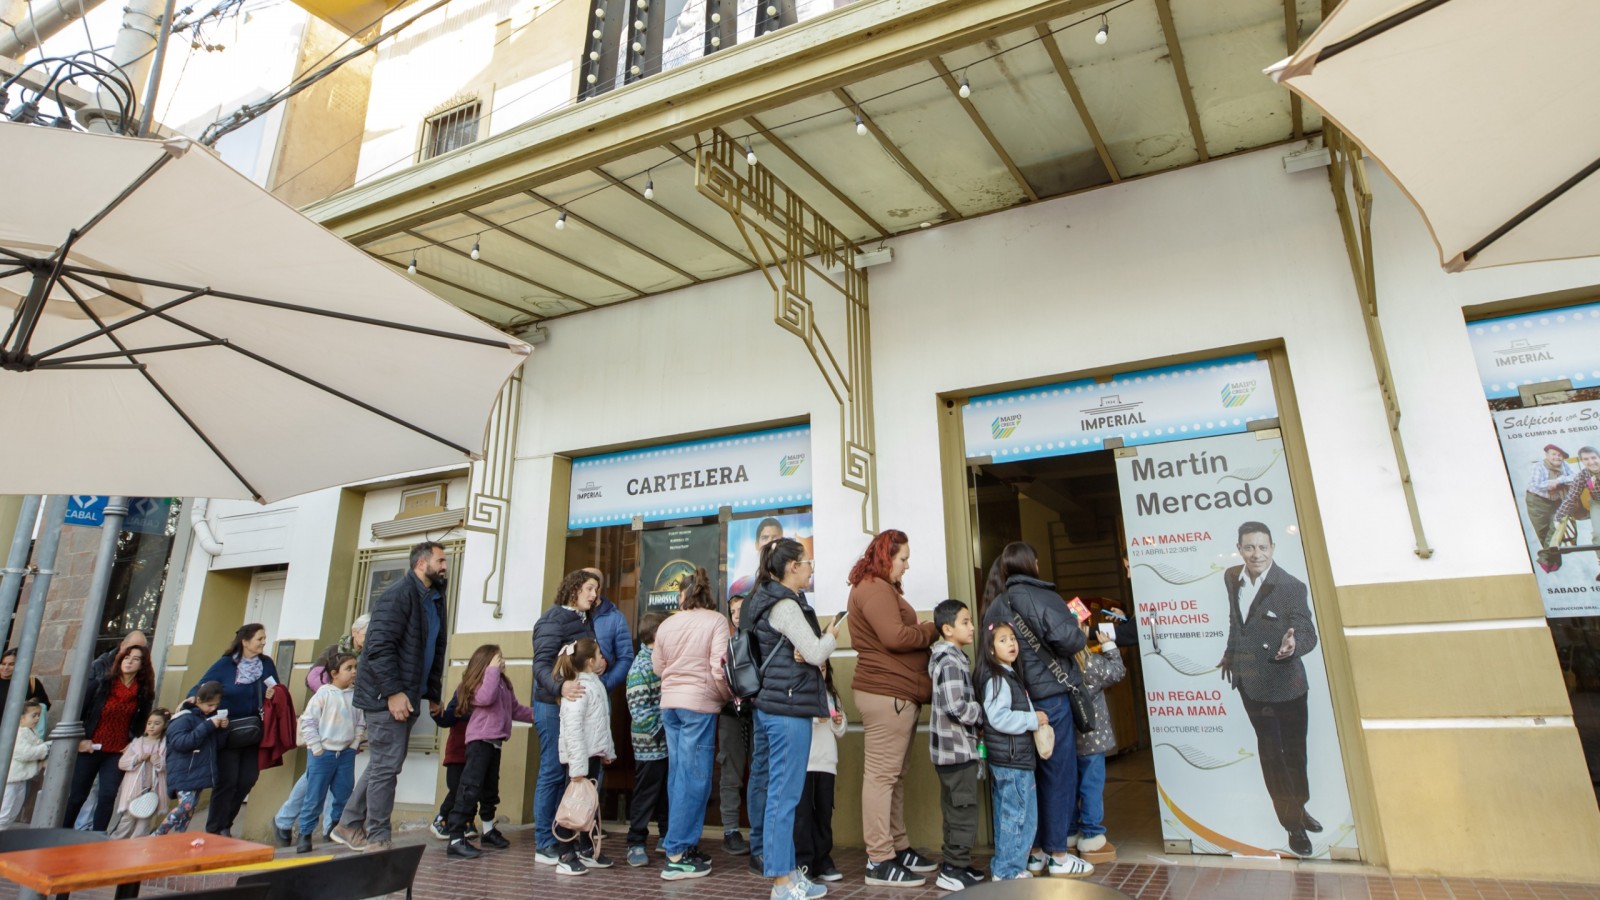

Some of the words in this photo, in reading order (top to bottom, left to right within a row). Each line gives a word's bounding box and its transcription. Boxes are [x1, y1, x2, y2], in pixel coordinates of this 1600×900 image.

[1495, 351, 1554, 367] IMPERIAL
[1231, 379, 1257, 389] MAIPÚ
[1000, 413, 1022, 423] MAIPÚ
[1081, 412, 1146, 431] IMPERIAL
[1503, 412, 1563, 430] Salpicón
[1579, 408, 1600, 421] So
[1508, 432, 1523, 440] LOS
[1525, 429, 1557, 438] CUMPAS
[1568, 424, 1598, 432] SERGIO
[1131, 451, 1228, 482] Martín
[627, 464, 749, 496] CARTELERA
[577, 491, 602, 500] IMPERIAL
[1136, 482, 1273, 516] Mercado
[65, 509, 97, 521] CABAL
[1131, 537, 1139, 547] A
[1142, 535, 1155, 546] MI
[1158, 531, 1212, 545] MANERA
[1145, 548, 1166, 556] ABRIL
[1547, 586, 1587, 594] SABADO
[1139, 599, 1177, 613] MAIPÚ
[1180, 600, 1198, 610] DE
[1013, 614, 1041, 653] TROPEA
[1155, 631, 1200, 640] SEPTIEMBRE
[1147, 692, 1165, 701] UN
[1168, 690, 1221, 701] REGALO
[1149, 706, 1184, 716] PARA
[1187, 702, 1226, 716] MAMÁ
